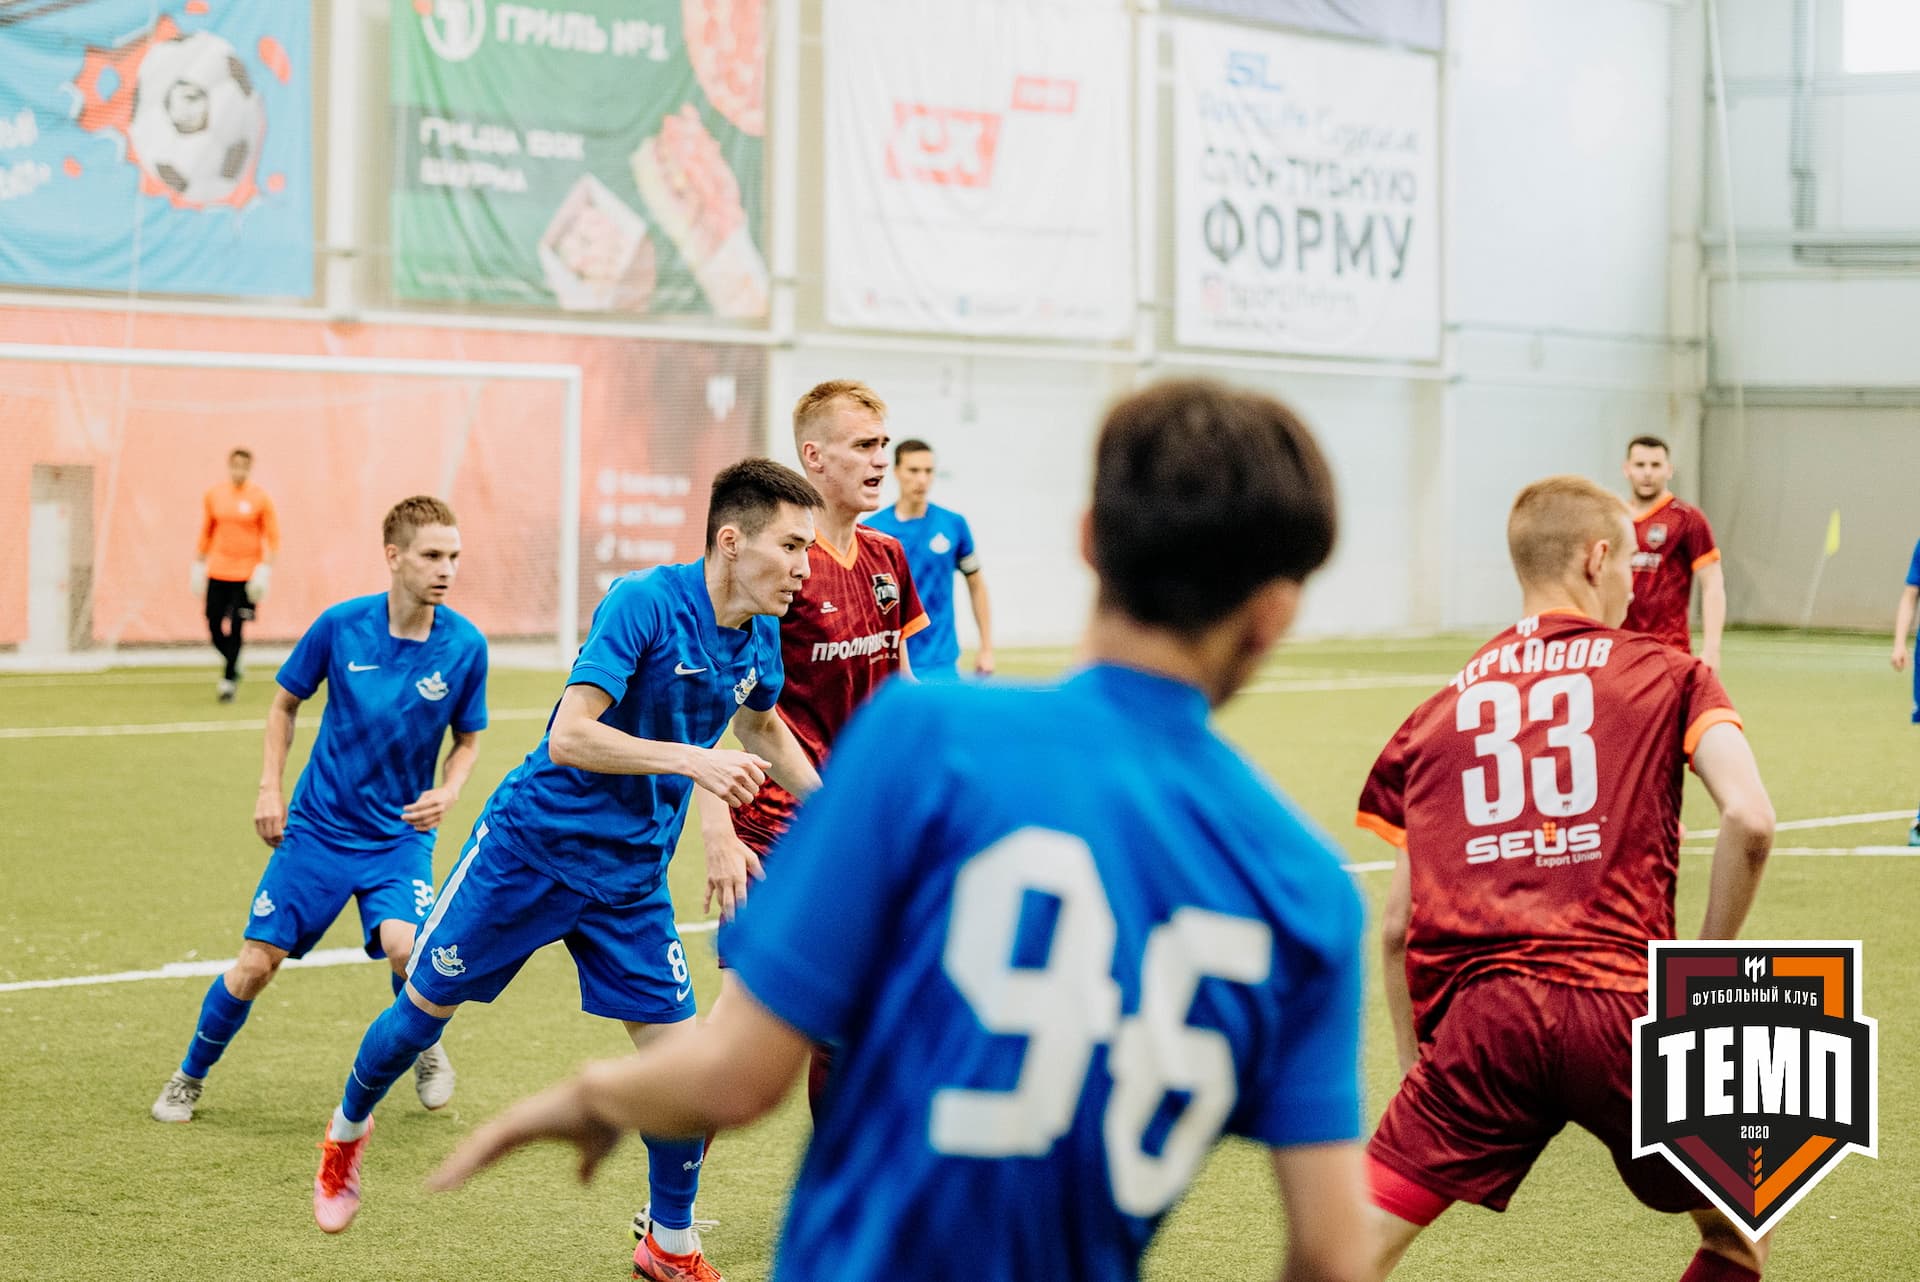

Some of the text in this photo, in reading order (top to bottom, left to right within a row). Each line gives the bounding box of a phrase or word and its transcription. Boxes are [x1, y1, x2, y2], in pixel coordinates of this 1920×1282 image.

[495, 4, 608, 54] ГРИЛЬ
[1203, 198, 1414, 281] ФОРМУ
[1456, 673, 1599, 827] 33
[1535, 850, 1602, 868] Export Union
[667, 940, 688, 983] 8
[928, 825, 1273, 1219] 96
